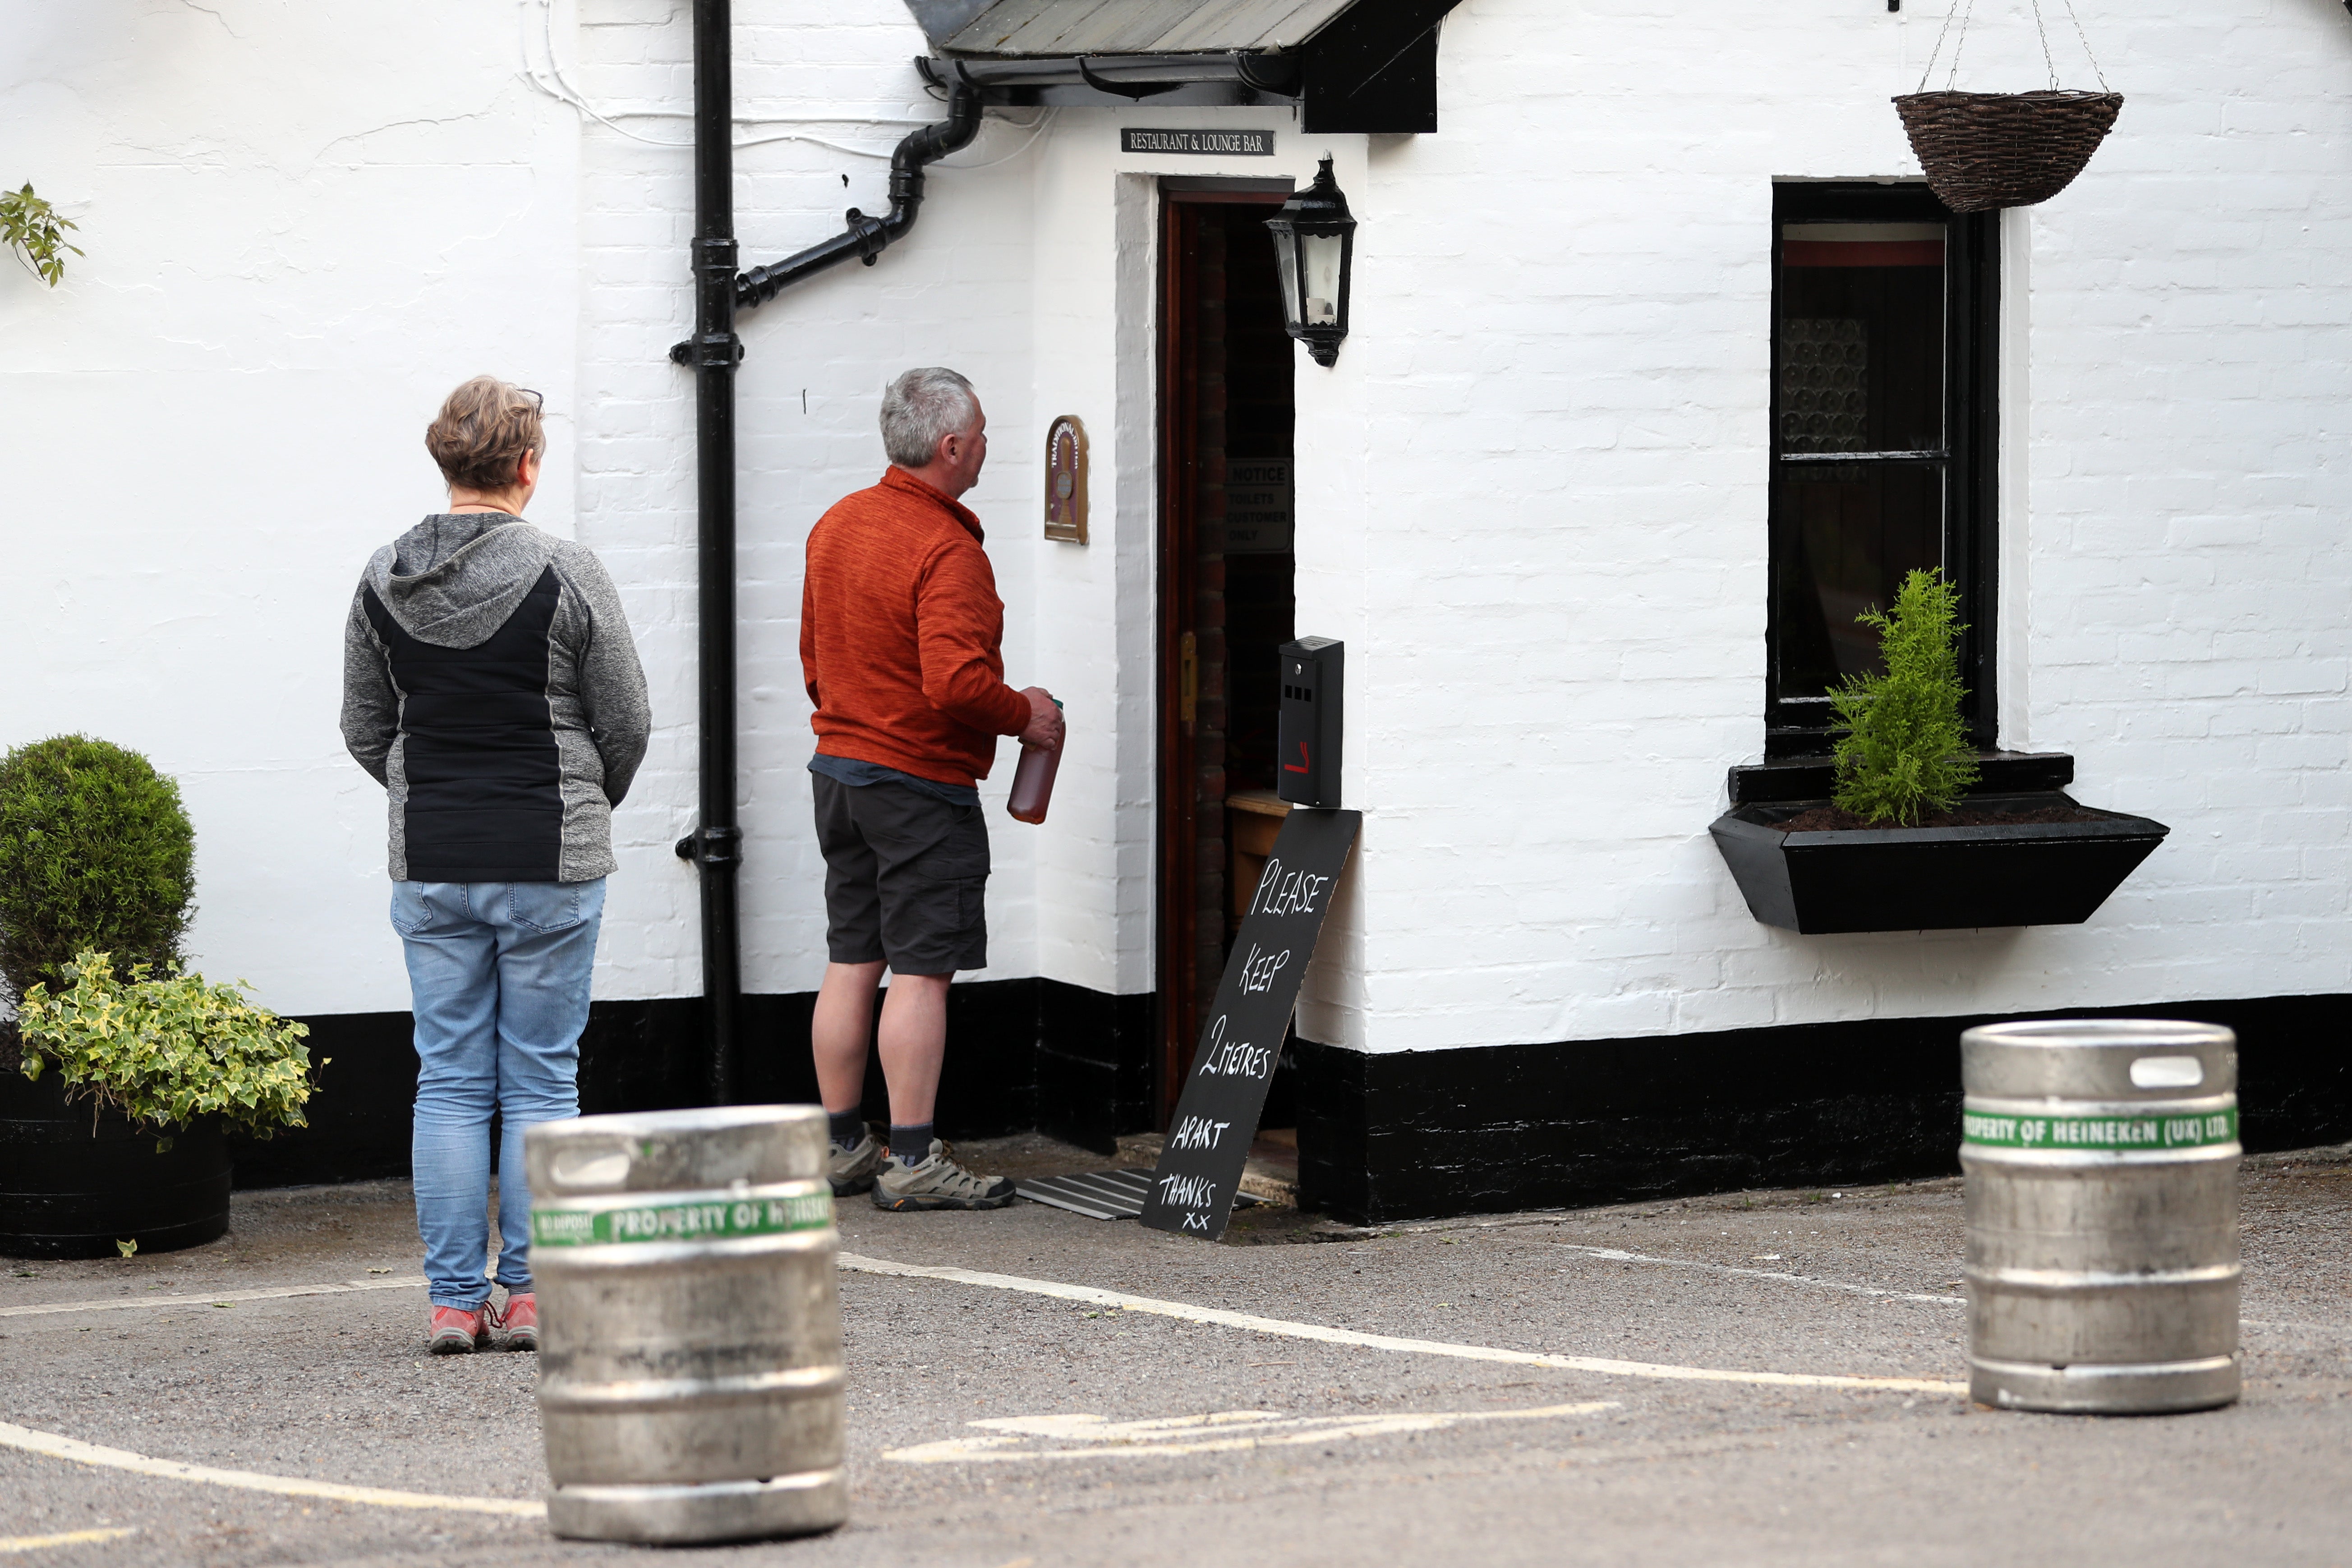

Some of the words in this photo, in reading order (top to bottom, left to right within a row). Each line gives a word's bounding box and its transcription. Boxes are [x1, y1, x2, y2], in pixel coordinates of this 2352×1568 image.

[1130, 133, 1188, 150] RESTAURANT
[1191, 134, 1200, 150] &
[1203, 134, 1241, 152] LOUNGE
[1244, 135, 1264, 152] BAR
[1051, 422, 1074, 468] TRADITIONAL
[1233, 467, 1285, 481] NOTICE
[1228, 493, 1275, 504] TOILETS
[1227, 512, 1287, 523] CUSTOMER
[1229, 530, 1258, 541] ONLY
[1251, 858, 1329, 917] PLEASE
[1239, 943, 1290, 995] KEEP
[1199, 1014, 1226, 1076] 2
[1217, 1041, 1271, 1079] METRES
[1172, 1115, 1230, 1150] APART
[2020, 1120, 2046, 1142] OF
[2053, 1120, 2158, 1143] HEINEKEN
[1159, 1173, 1216, 1208] THANKS
